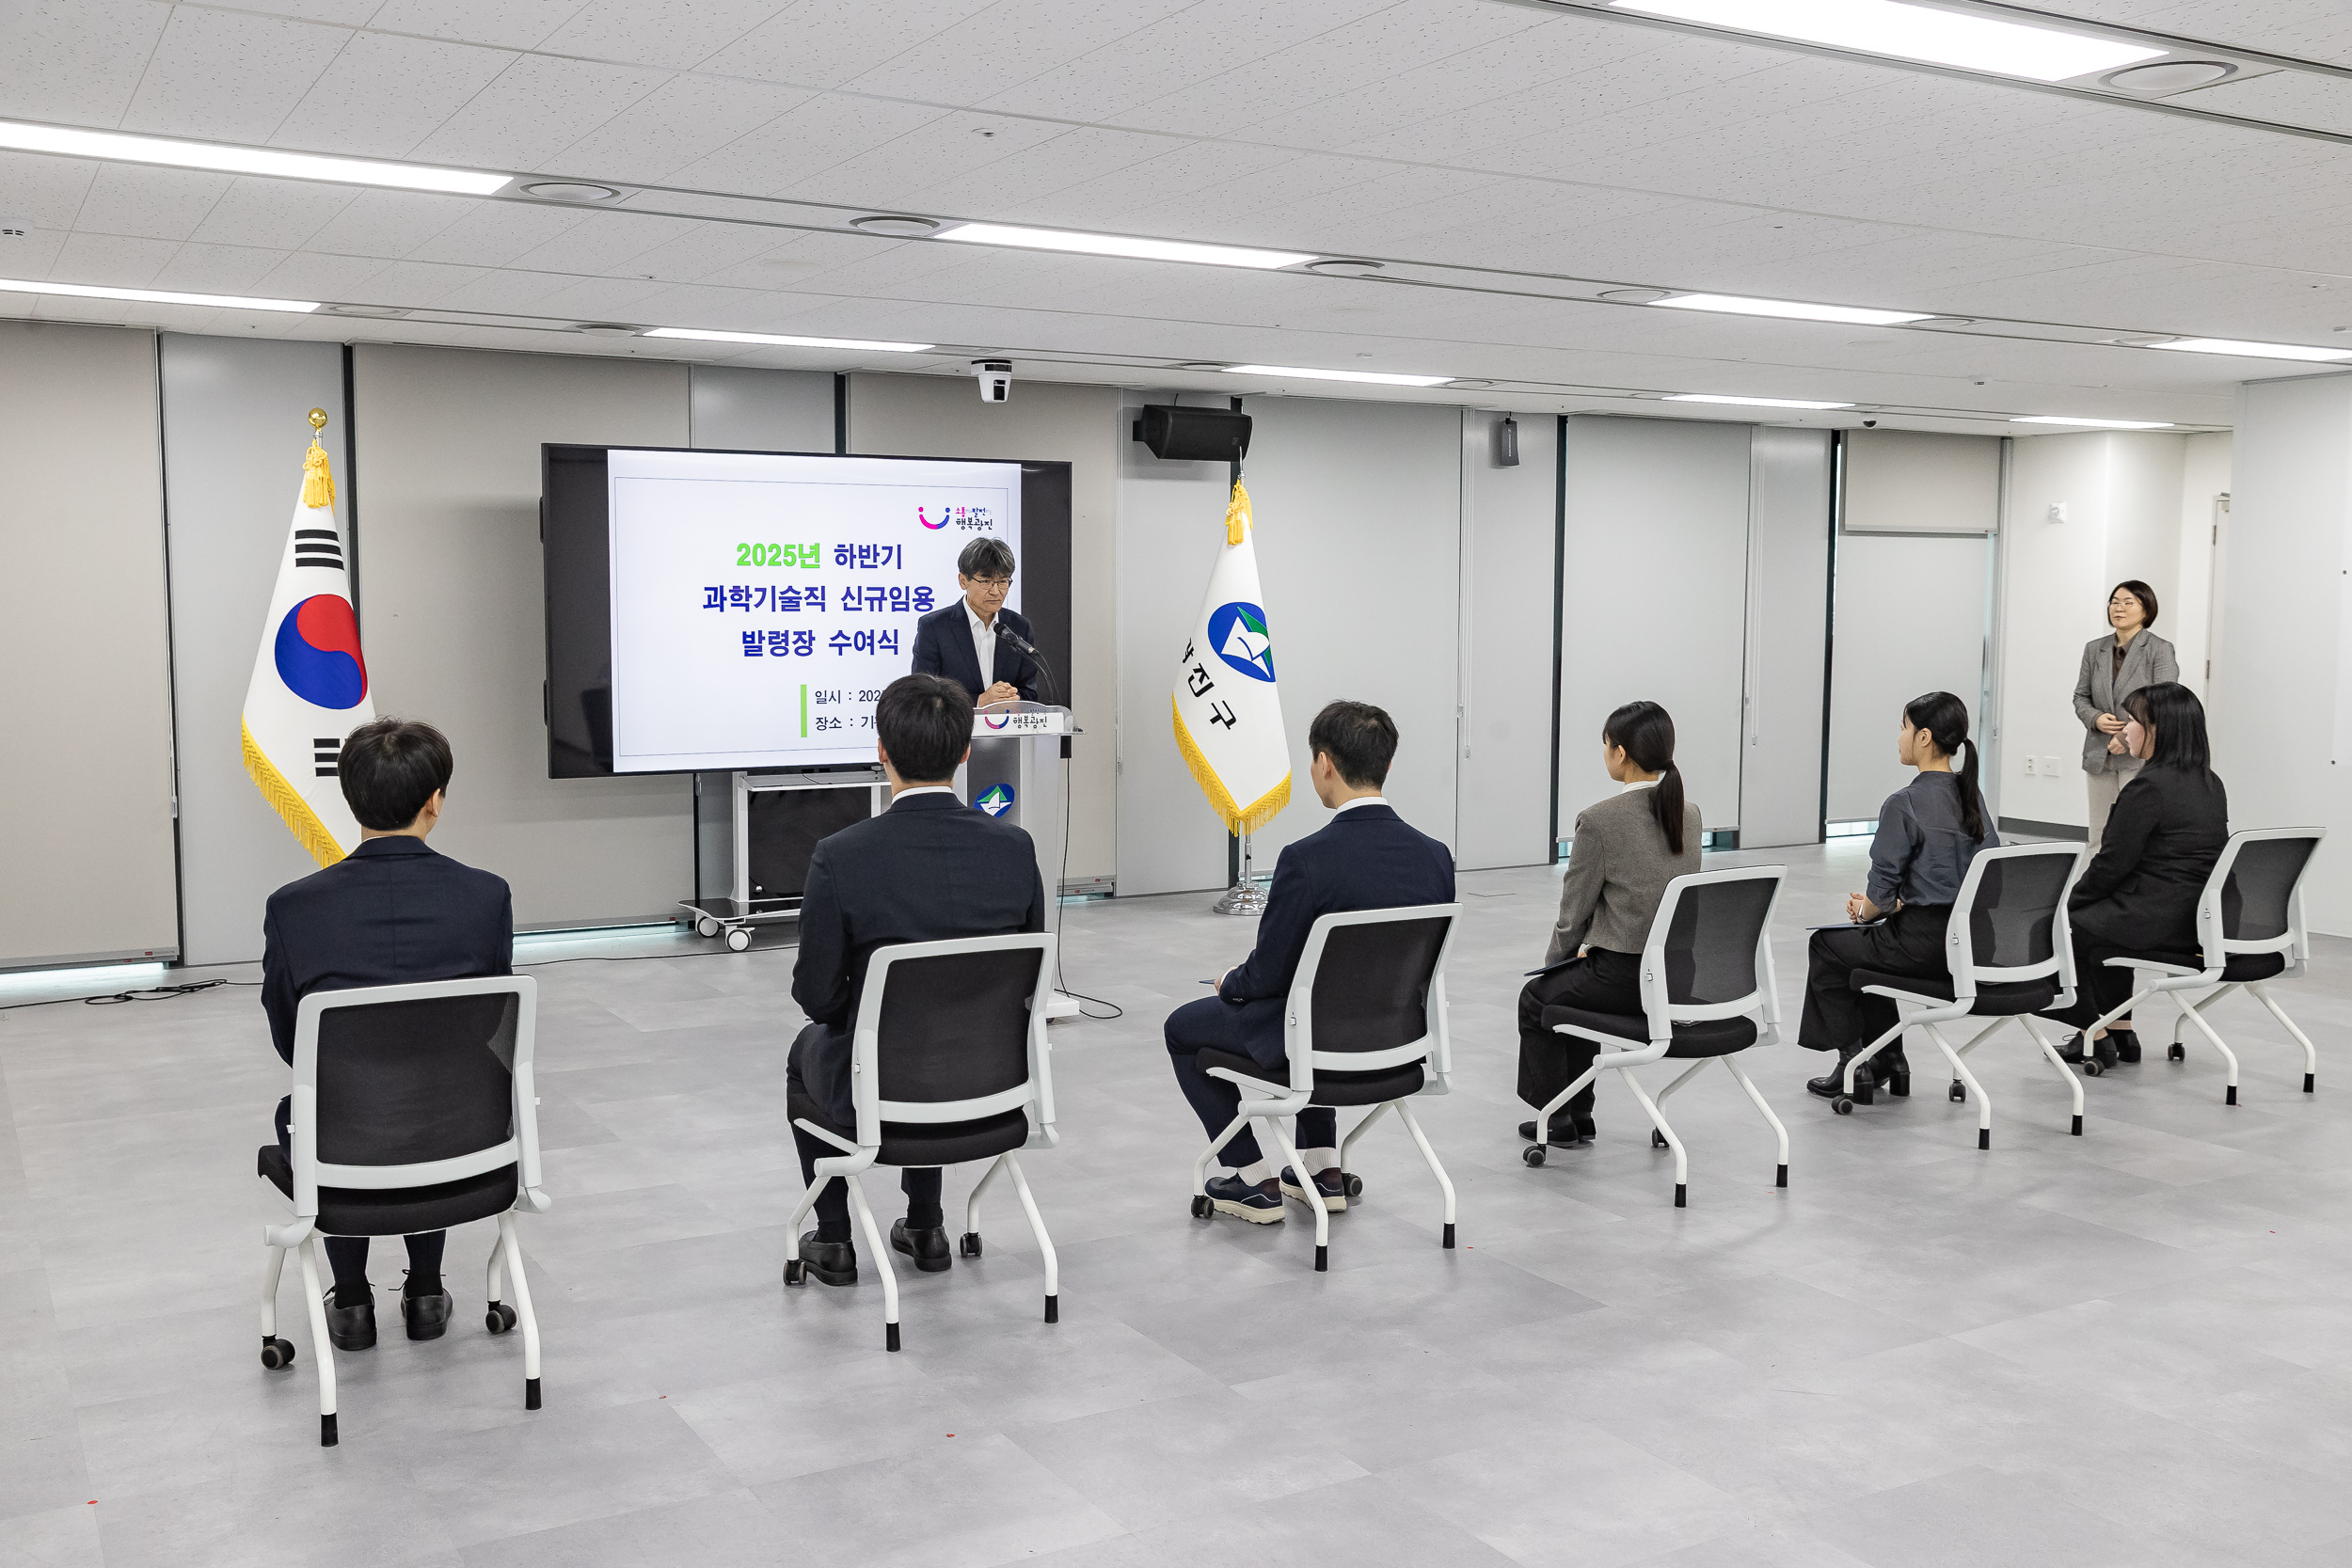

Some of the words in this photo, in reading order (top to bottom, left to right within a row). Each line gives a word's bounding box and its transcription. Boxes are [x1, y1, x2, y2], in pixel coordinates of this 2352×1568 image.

[955, 517, 993, 531] 행복광진
[736, 542, 820, 569] 2025년
[834, 543, 902, 570] 하반기
[702, 584, 826, 613] 과학기술직
[840, 585, 935, 612] 신규임용
[741, 629, 817, 657] 발령장
[828, 628, 898, 657] 수여식
[815, 689, 841, 705] 일시
[858, 689, 884, 702] 202
[815, 716, 843, 732] 장소
[861, 715, 877, 730] 기
[1012, 715, 1047, 729] 행복광진
